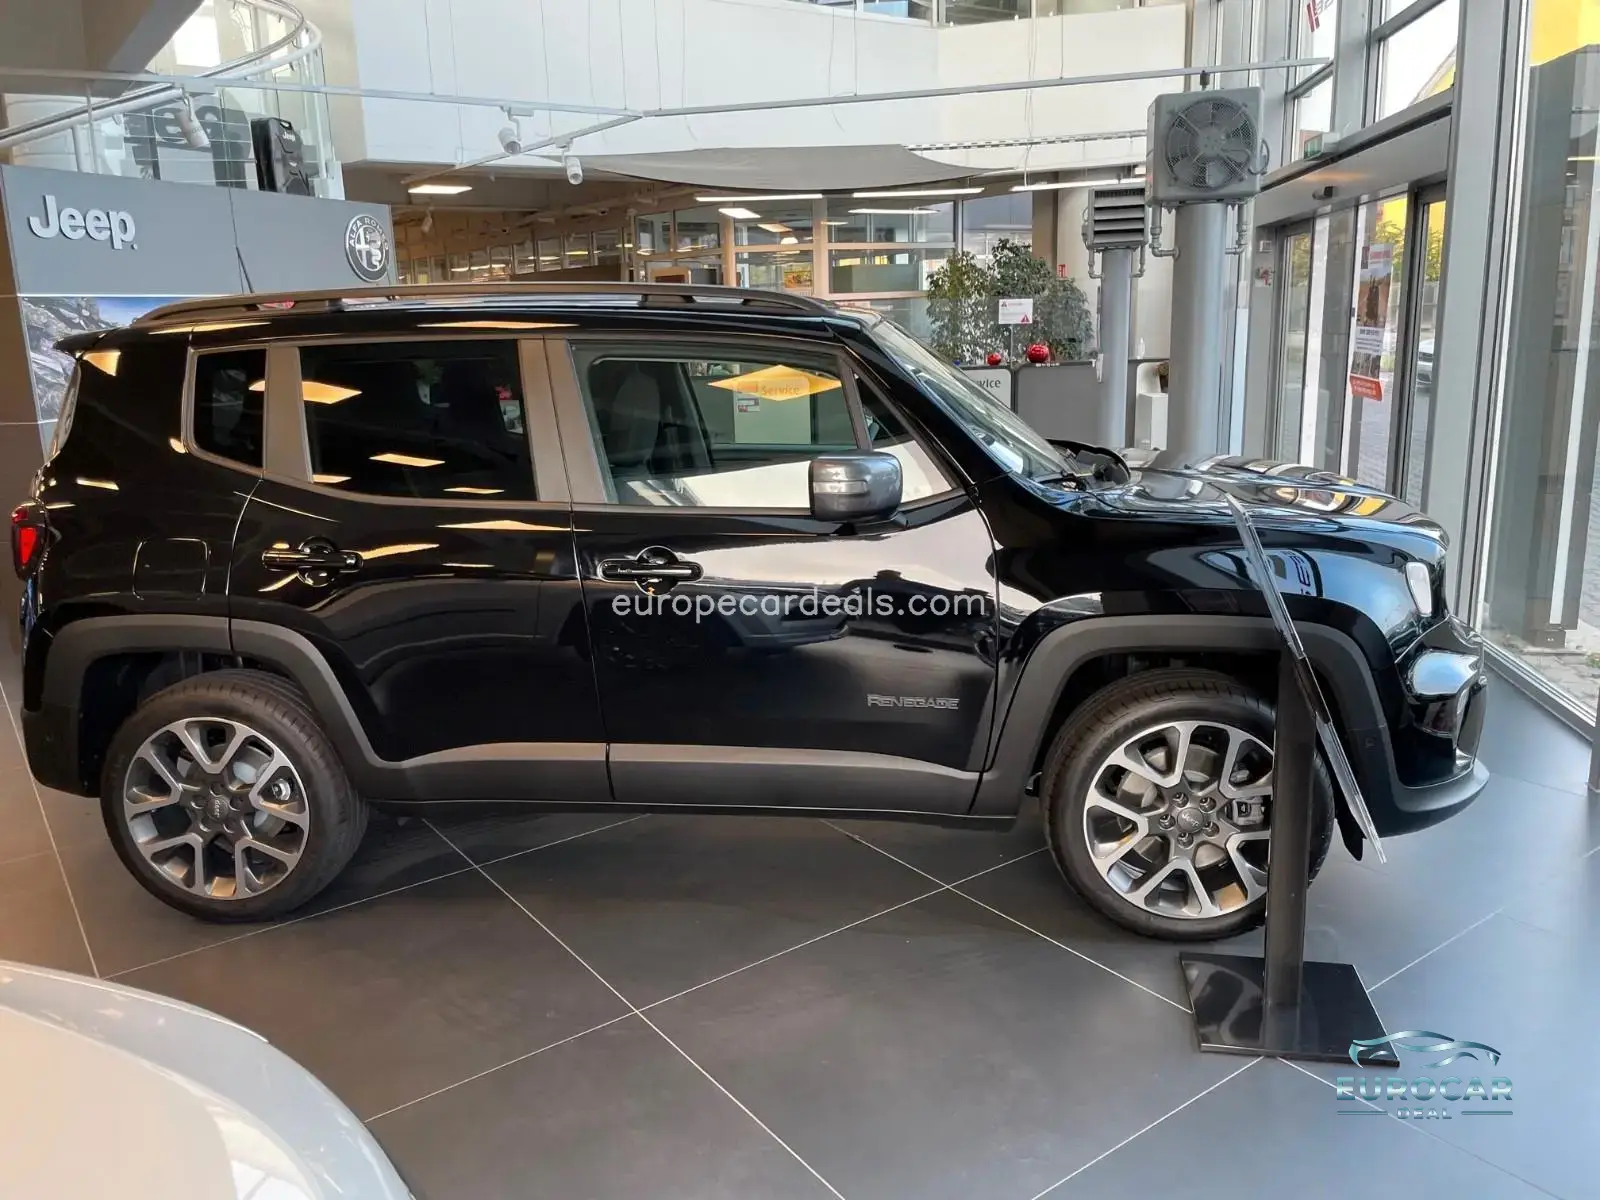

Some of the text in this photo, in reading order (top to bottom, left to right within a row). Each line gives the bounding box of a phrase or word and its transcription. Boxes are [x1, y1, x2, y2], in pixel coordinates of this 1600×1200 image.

[349, 219, 363, 247] ALFA
[761, 383, 802, 395] Service
[867, 693, 960, 710] RENEGADE
